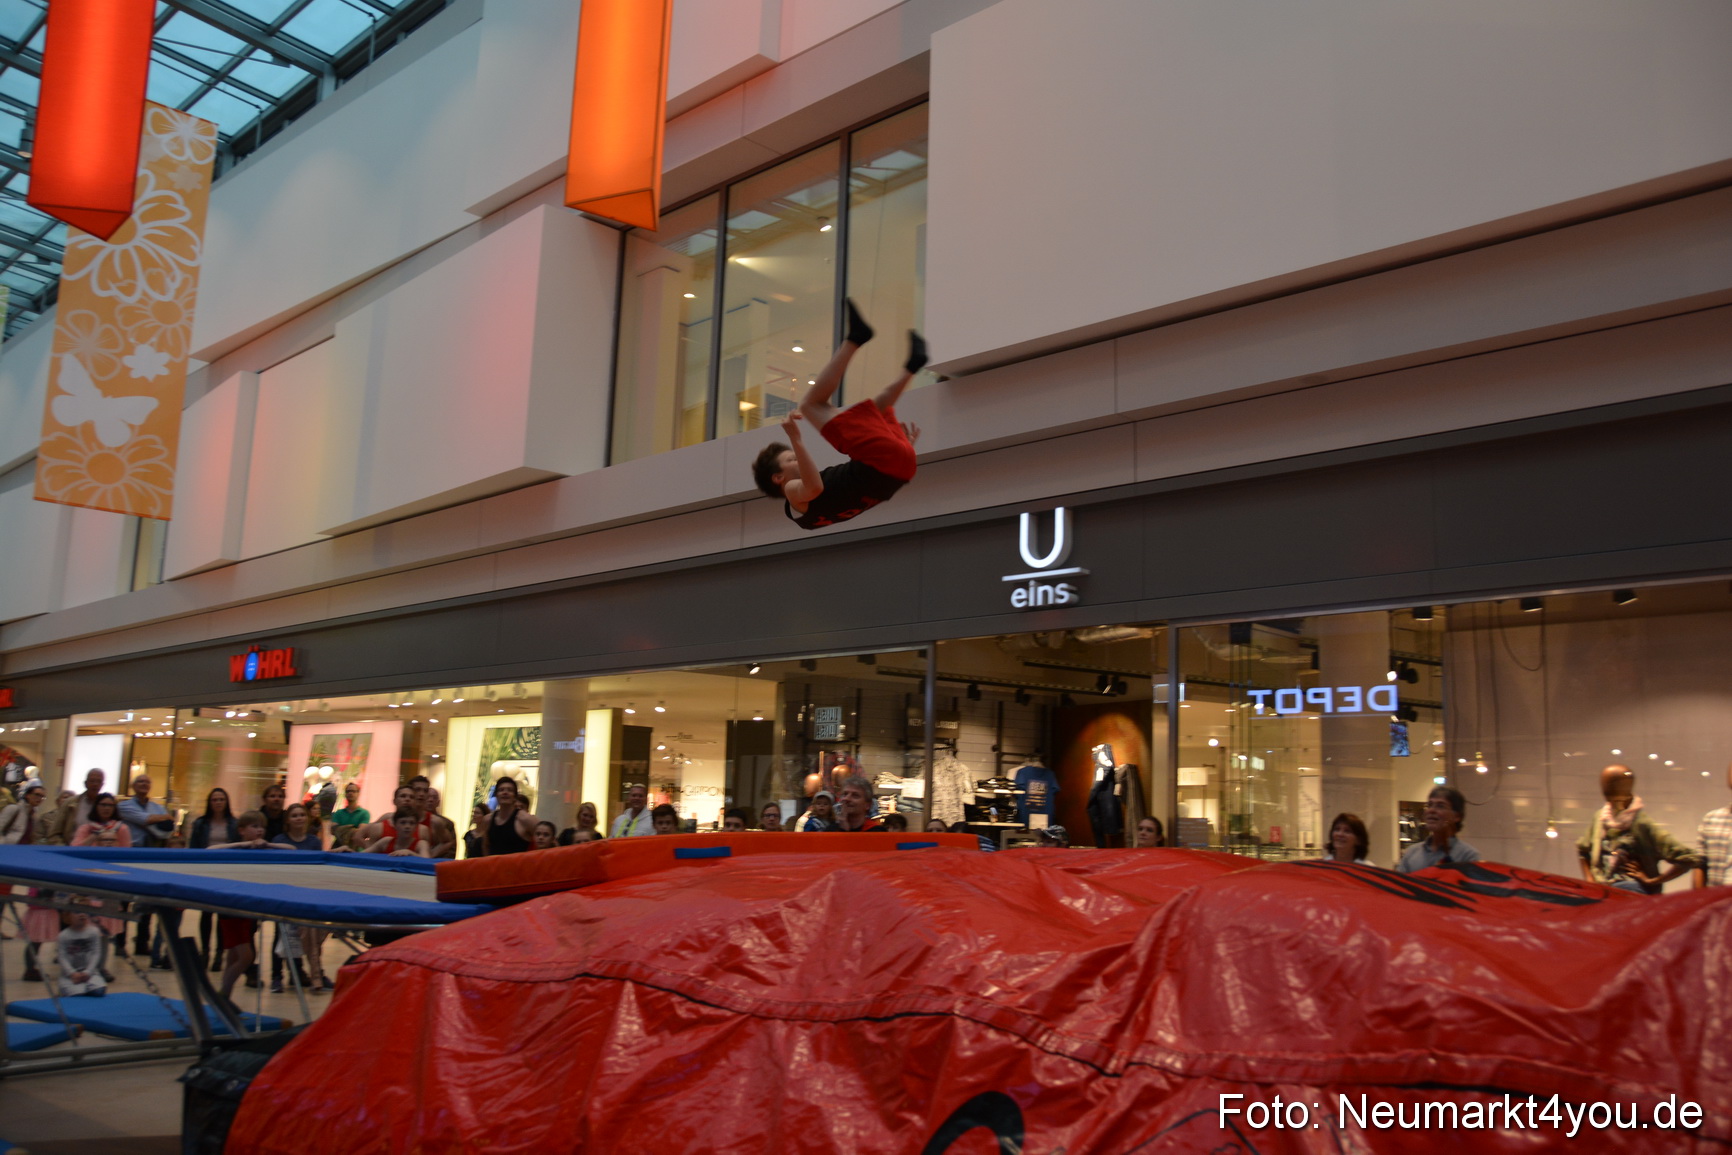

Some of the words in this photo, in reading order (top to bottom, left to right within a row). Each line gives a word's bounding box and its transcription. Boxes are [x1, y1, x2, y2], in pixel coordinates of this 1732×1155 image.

[1019, 506, 1067, 569] U
[1010, 580, 1073, 608] eins
[229, 645, 297, 683] WÖHRL
